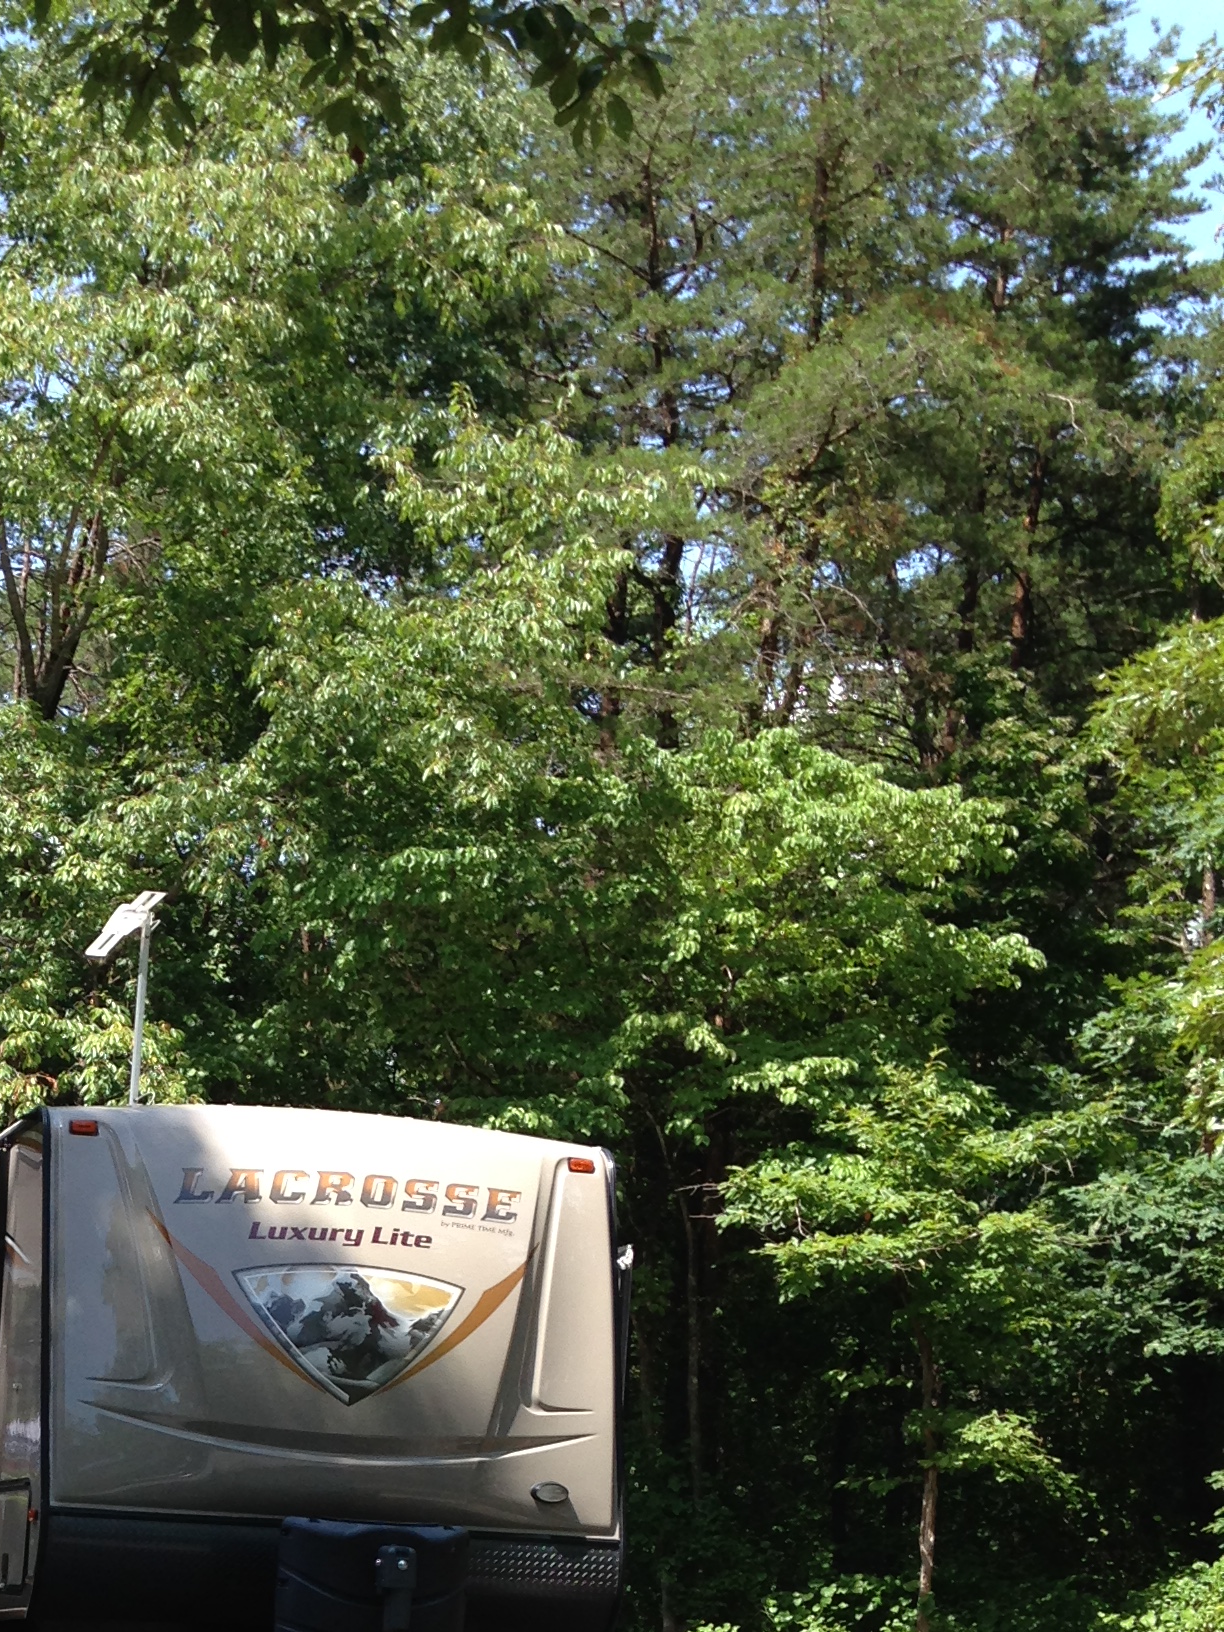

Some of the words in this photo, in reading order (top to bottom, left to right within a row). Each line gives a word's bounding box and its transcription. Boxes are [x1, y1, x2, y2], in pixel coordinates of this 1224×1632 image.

[174, 1167, 522, 1224] LACROSSE
[248, 1221, 364, 1247] Luxury
[371, 1226, 433, 1249] Lite
[440, 1220, 450, 1228] by
[478, 1225, 495, 1234] TIME
